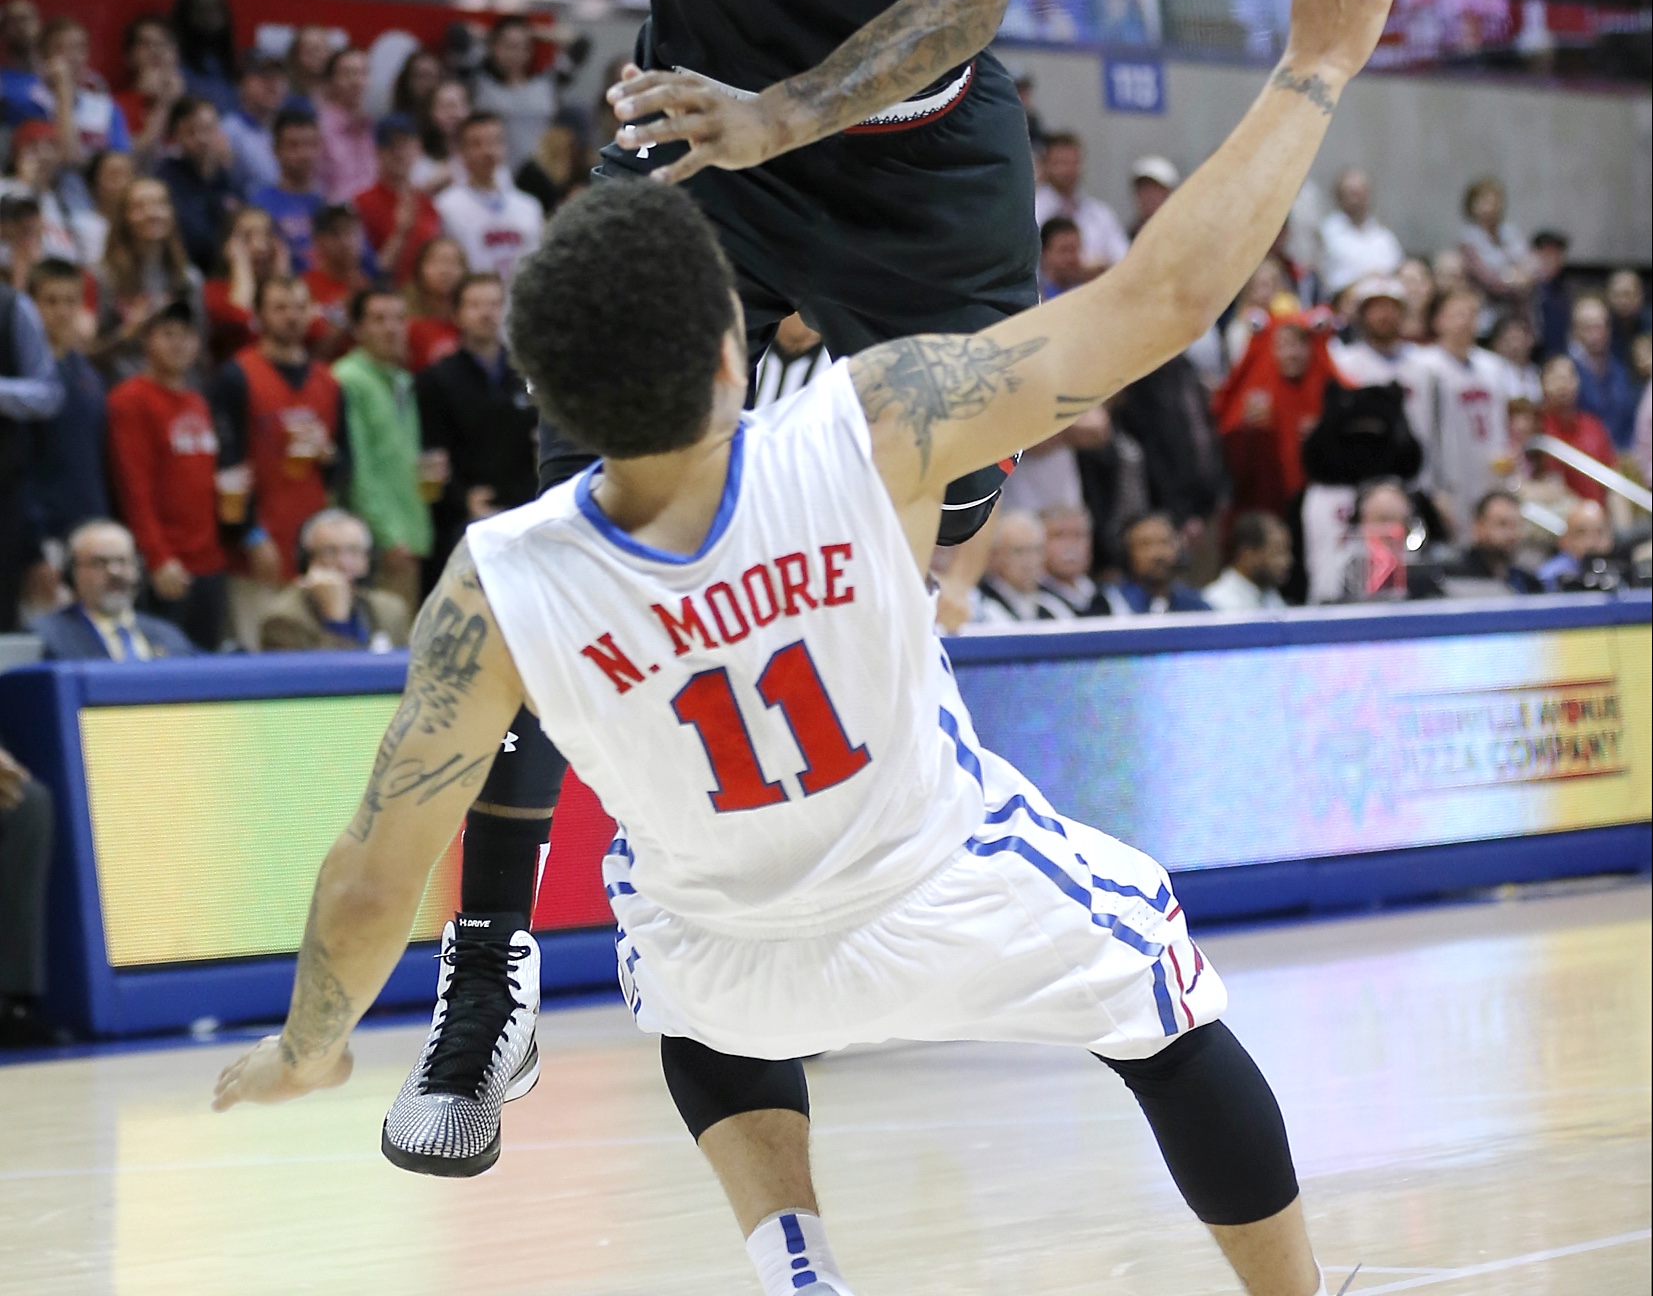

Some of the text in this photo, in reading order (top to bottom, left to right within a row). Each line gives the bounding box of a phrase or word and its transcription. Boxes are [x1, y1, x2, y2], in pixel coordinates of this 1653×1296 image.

[580, 542, 854, 695] N. MOORE
[669, 638, 872, 814] 11
[467, 919, 491, 927] DRIVE
